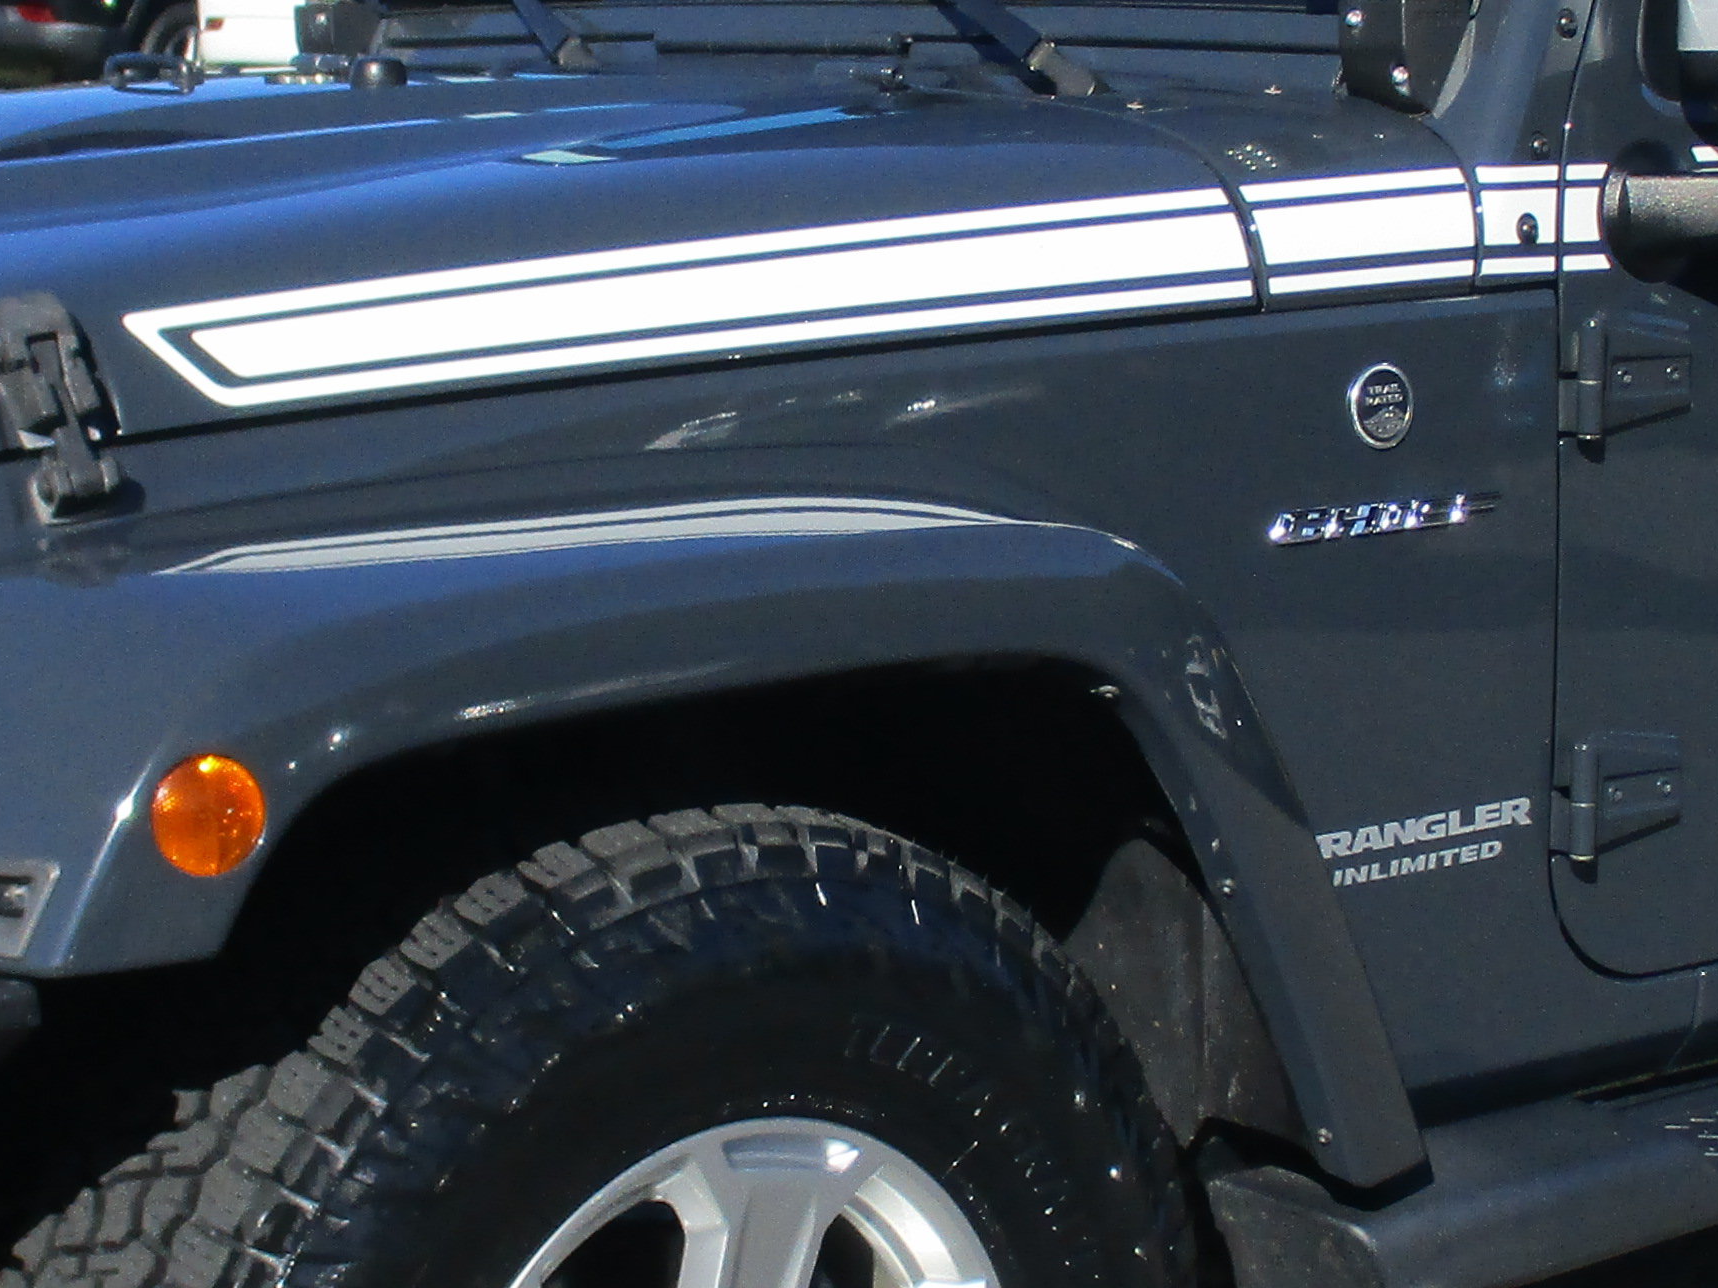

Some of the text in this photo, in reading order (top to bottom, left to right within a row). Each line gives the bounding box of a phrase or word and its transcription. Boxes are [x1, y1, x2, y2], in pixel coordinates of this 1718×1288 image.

[1367, 383, 1401, 395] TRAIL
[1364, 393, 1404, 406] RATED
[1315, 797, 1533, 859] RANGLER
